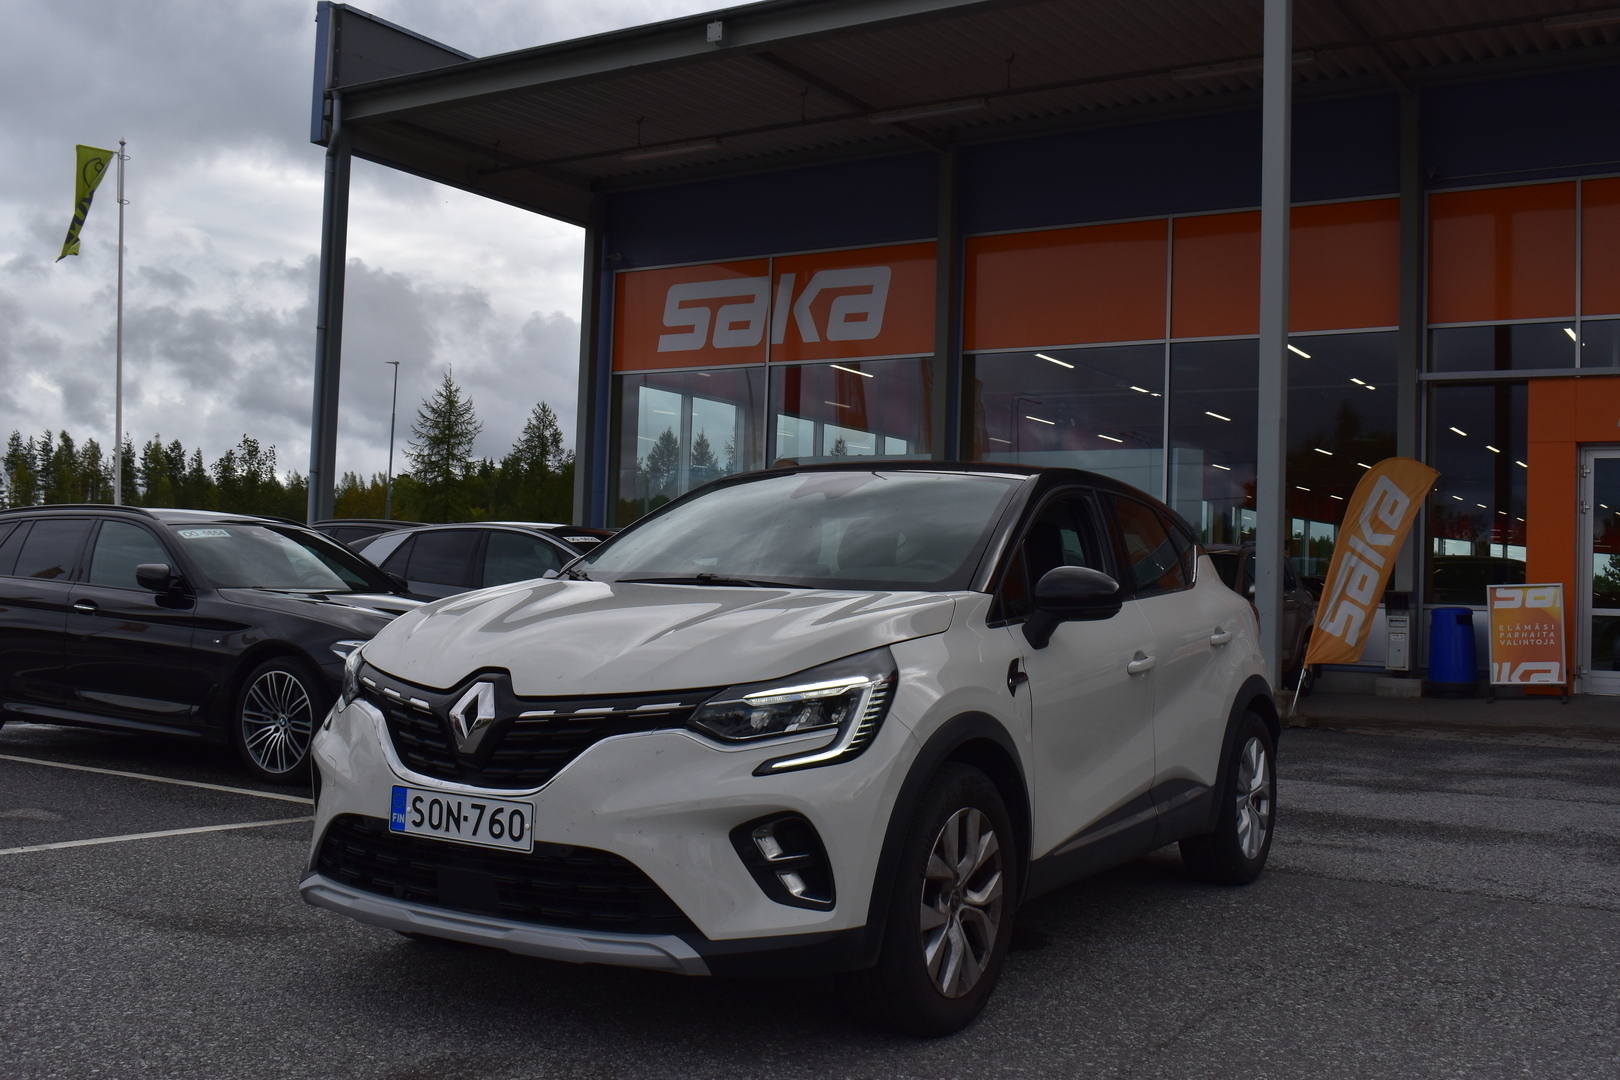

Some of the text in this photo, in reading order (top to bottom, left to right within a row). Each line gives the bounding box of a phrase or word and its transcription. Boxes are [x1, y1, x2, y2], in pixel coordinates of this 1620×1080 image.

[1499, 623, 1555, 631] ELÄMÄSI
[1500, 638, 1555, 646] VALINTOJA
[392, 812, 405, 824] FIN
[411, 795, 525, 842] SON-760
